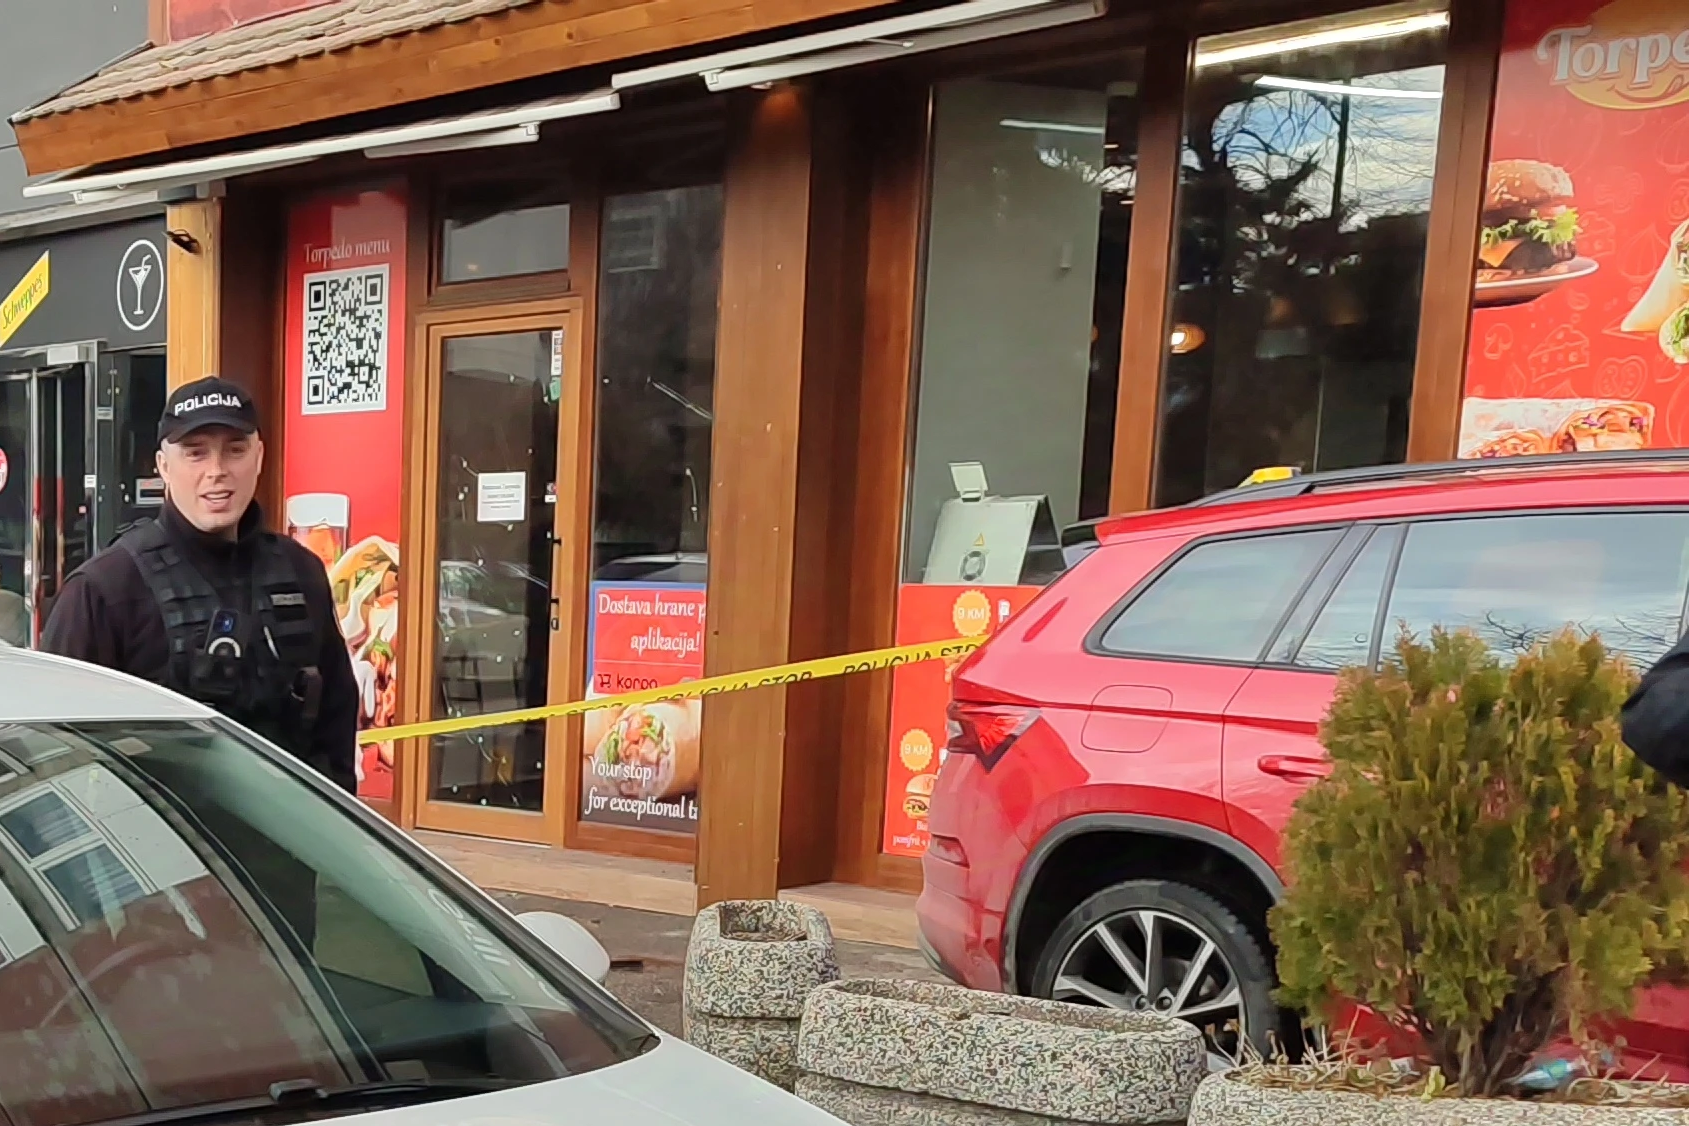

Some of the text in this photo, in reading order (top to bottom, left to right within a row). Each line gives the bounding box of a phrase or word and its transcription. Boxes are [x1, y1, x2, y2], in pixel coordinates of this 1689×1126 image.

[304, 237, 391, 269] Torpedo menu
[2, 273, 43, 330] Schweppes
[174, 393, 242, 417] POLICIJA
[598, 593, 652, 616] Dostava
[655, 592, 695, 617] hrane
[957, 608, 985, 621] 9 KM
[630, 626, 700, 659] aplikacija!
[913, 745, 928, 756] KM
[589, 755, 652, 788] Your stop
[584, 785, 608, 815] for
[610, 795, 686, 821] exceptional
